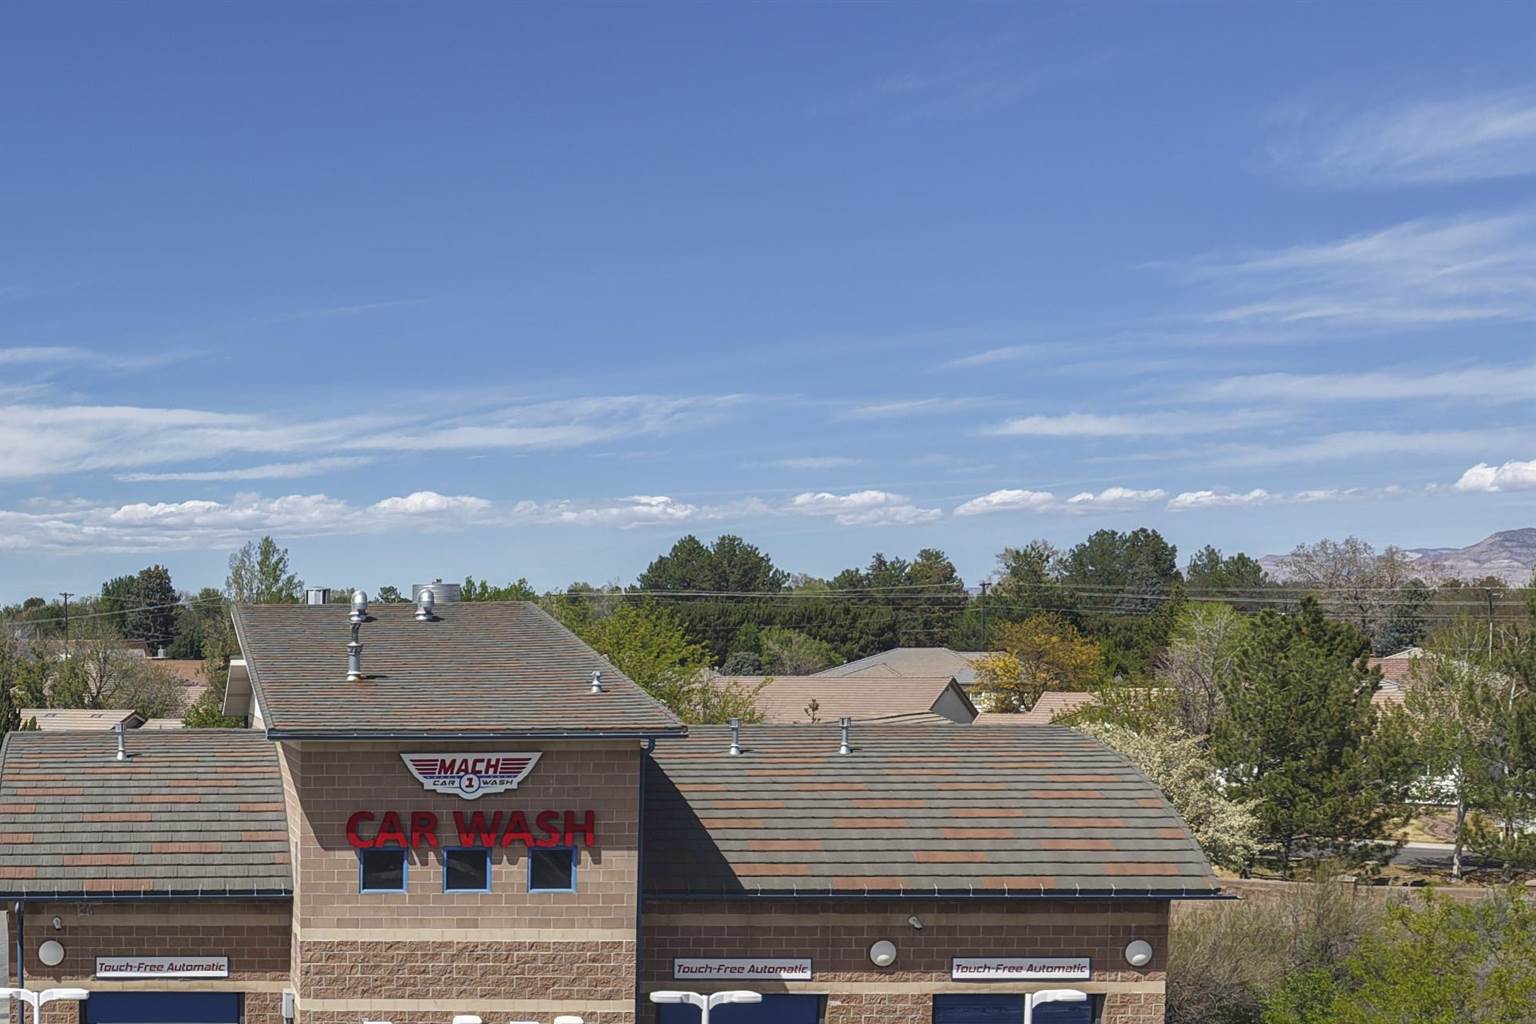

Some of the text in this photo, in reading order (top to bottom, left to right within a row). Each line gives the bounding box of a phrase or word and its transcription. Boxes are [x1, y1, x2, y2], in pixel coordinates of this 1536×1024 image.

[437, 758, 501, 775] MACH
[465, 777, 475, 788] 1
[346, 809, 595, 849] CAR WASH
[98, 962, 225, 972] Touch-Free Automatic
[676, 964, 809, 974] Touch-Free Automatic
[955, 963, 1087, 973] Touch-Free Automatic
